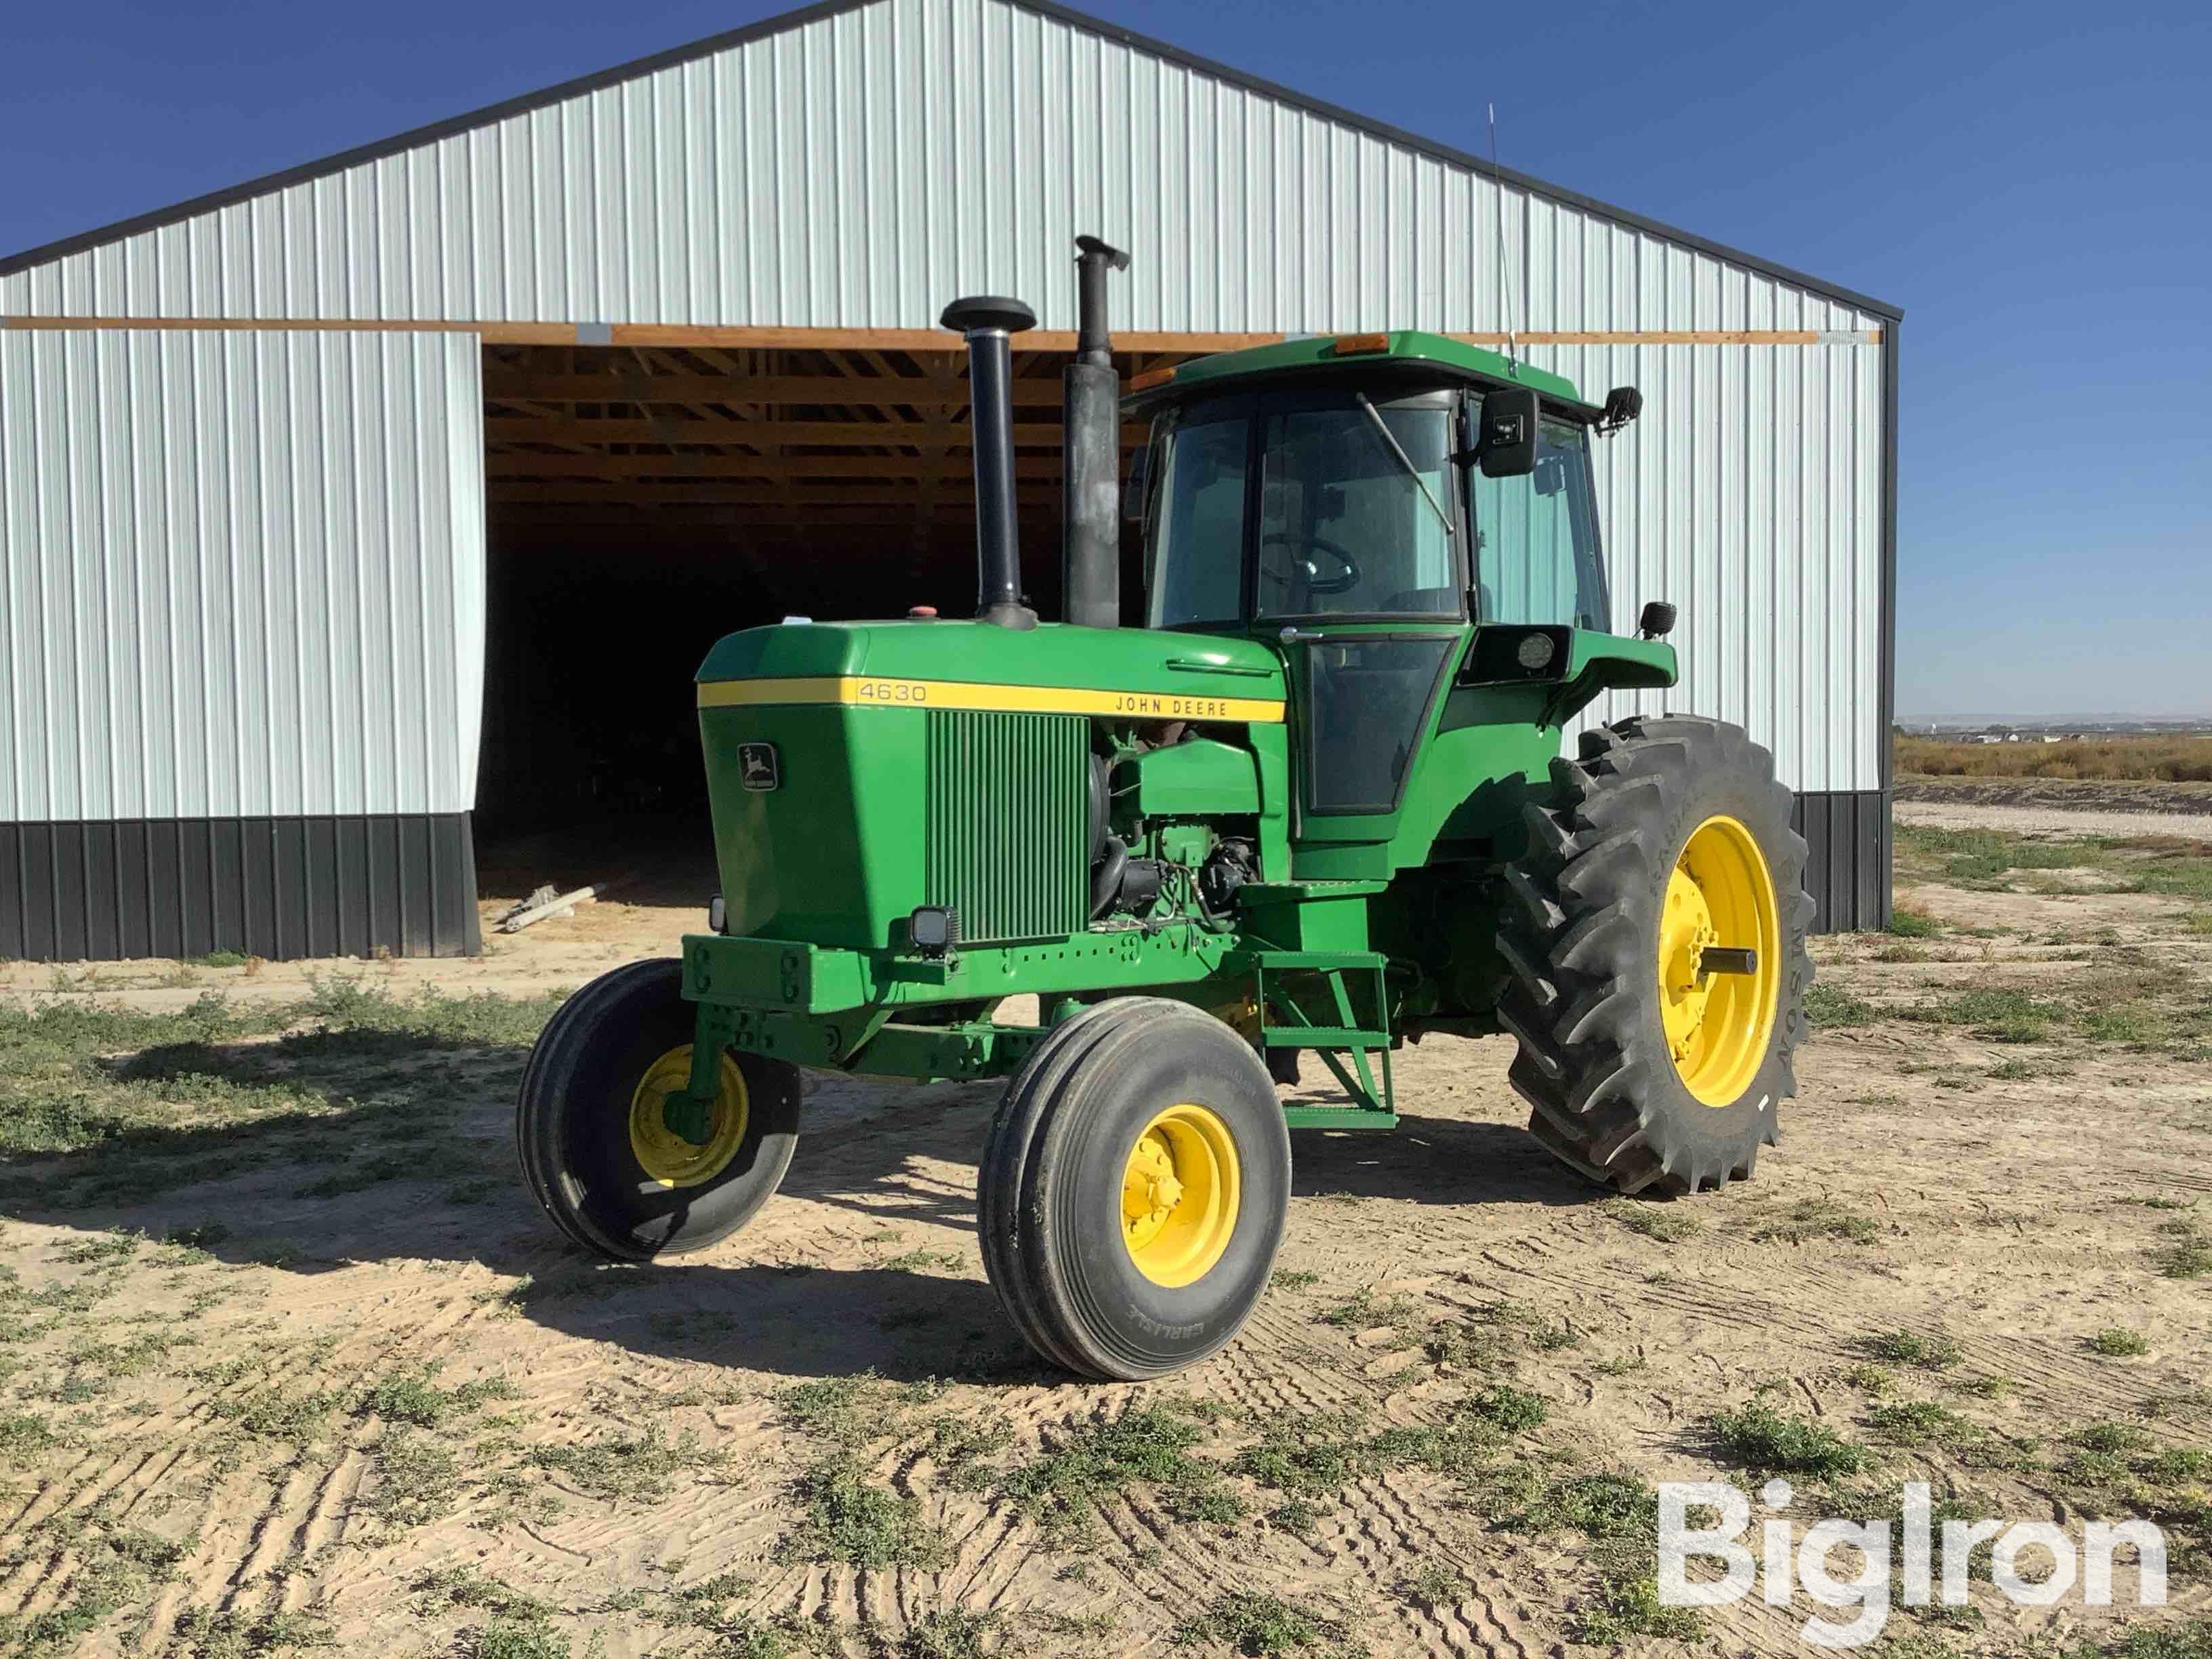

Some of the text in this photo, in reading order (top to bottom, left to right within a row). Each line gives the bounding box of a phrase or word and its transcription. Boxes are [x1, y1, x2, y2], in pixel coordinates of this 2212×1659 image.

[860, 683, 926, 701] 4630
[1116, 697, 1226, 716] JOHN DEERE
